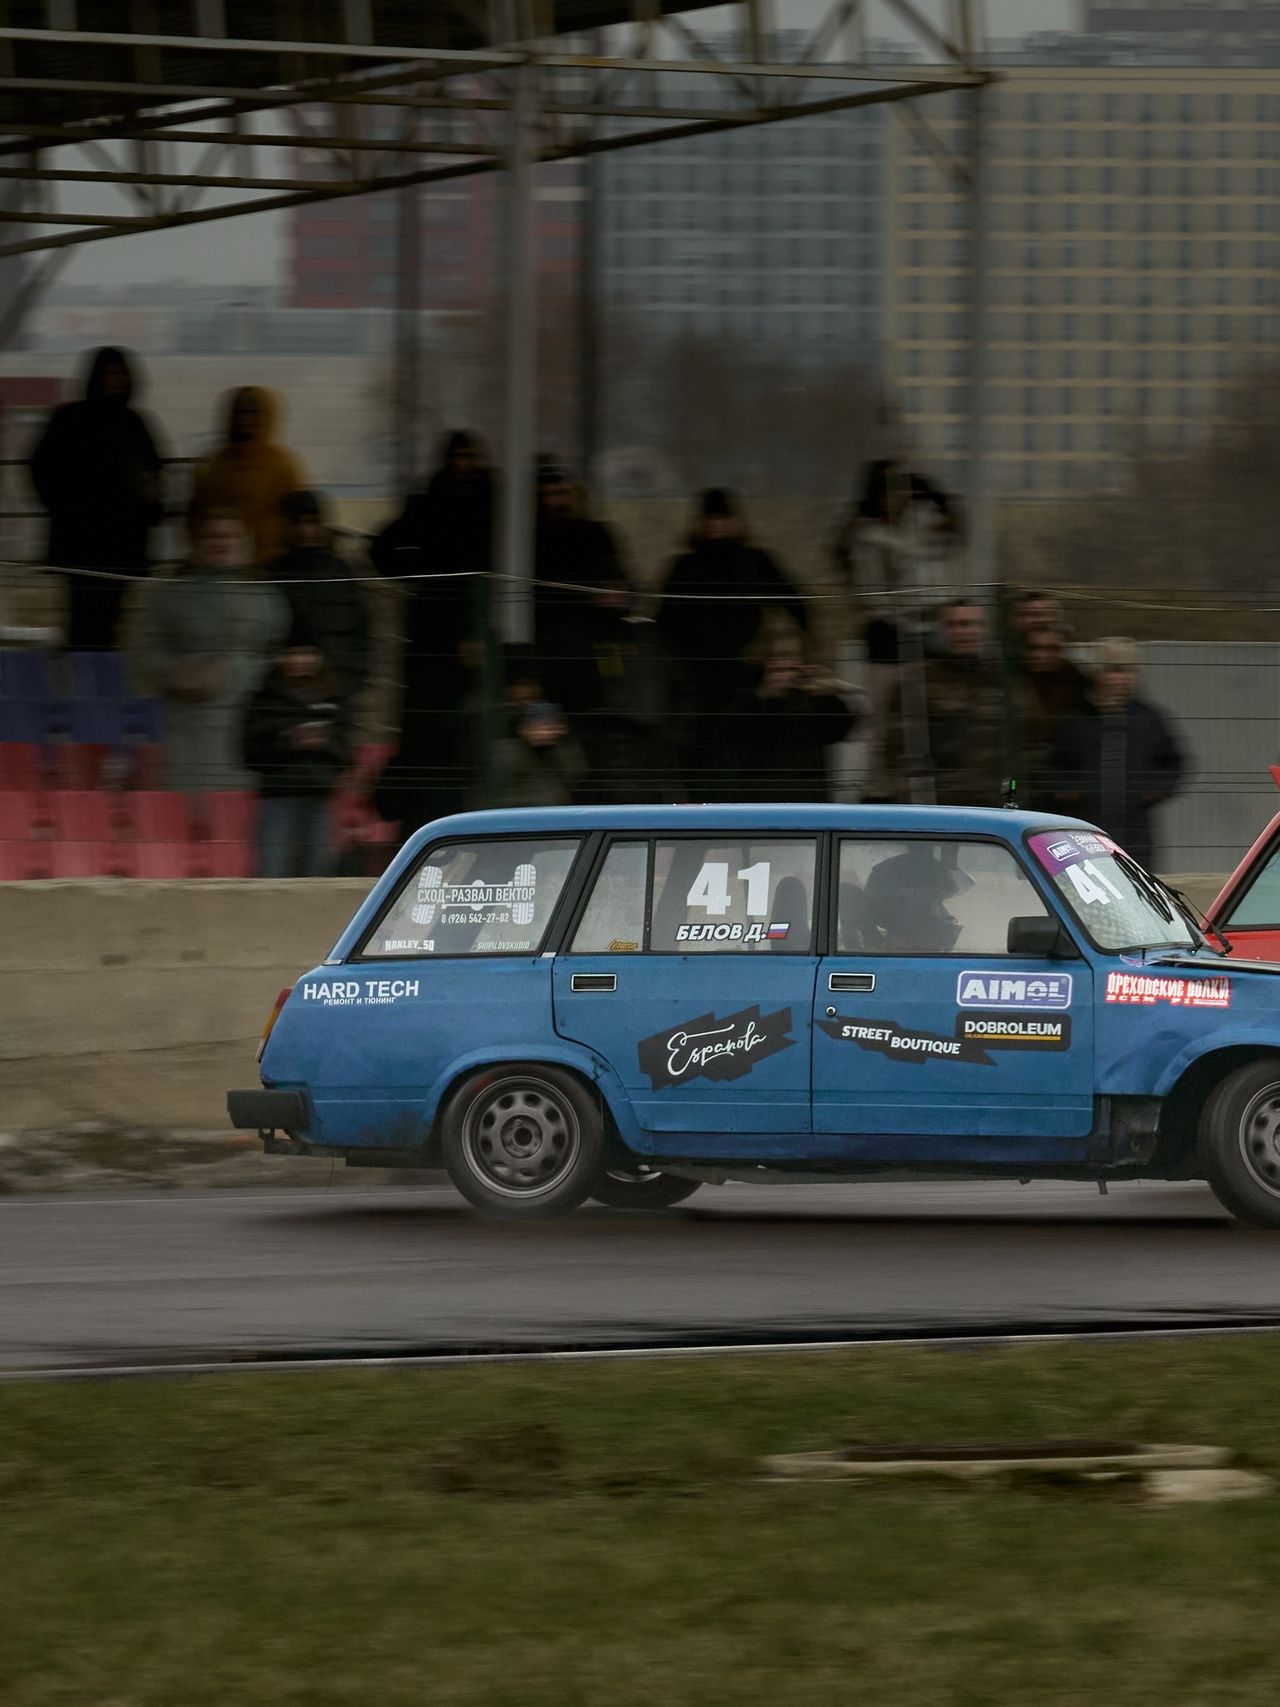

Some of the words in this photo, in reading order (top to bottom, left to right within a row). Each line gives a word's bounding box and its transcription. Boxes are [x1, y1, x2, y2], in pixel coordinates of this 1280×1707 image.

[686, 862, 770, 916] 41
[1065, 859, 1124, 905] 41
[417, 889, 492, 904] СХОД-РАЗВАЛ
[495, 887, 536, 902] ВЕКТОР
[441, 914, 447, 924] 8
[448, 913, 467, 924] (926)
[676, 924, 743, 941] БЕЛОВ
[743, 923, 767, 943] Д.
[304, 982, 360, 999] HARD
[366, 980, 419, 997] TECH
[961, 979, 1065, 1001] AIMOL
[324, 998, 355, 1006] РЕМОНТ
[842, 1025, 893, 1041] STREET
[965, 1020, 1062, 1035] DOBROLEUM
[890, 1036, 962, 1055] BOUTIQUE
